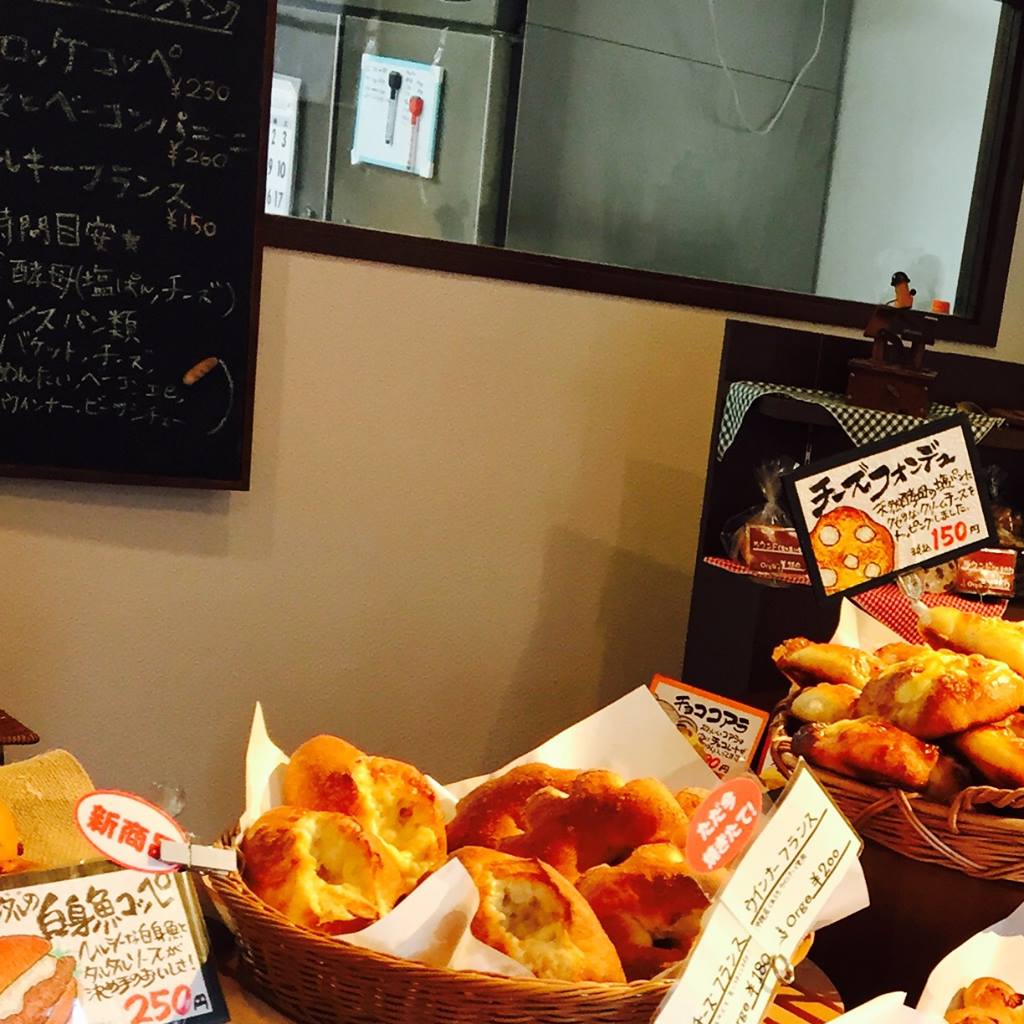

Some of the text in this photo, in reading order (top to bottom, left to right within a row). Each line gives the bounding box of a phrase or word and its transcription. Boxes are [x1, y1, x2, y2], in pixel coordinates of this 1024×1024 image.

[809, 439, 955, 519] チーズフォンデュ
[674, 695, 750, 733] チョココアラ
[785, 893, 813, 928] Orge
